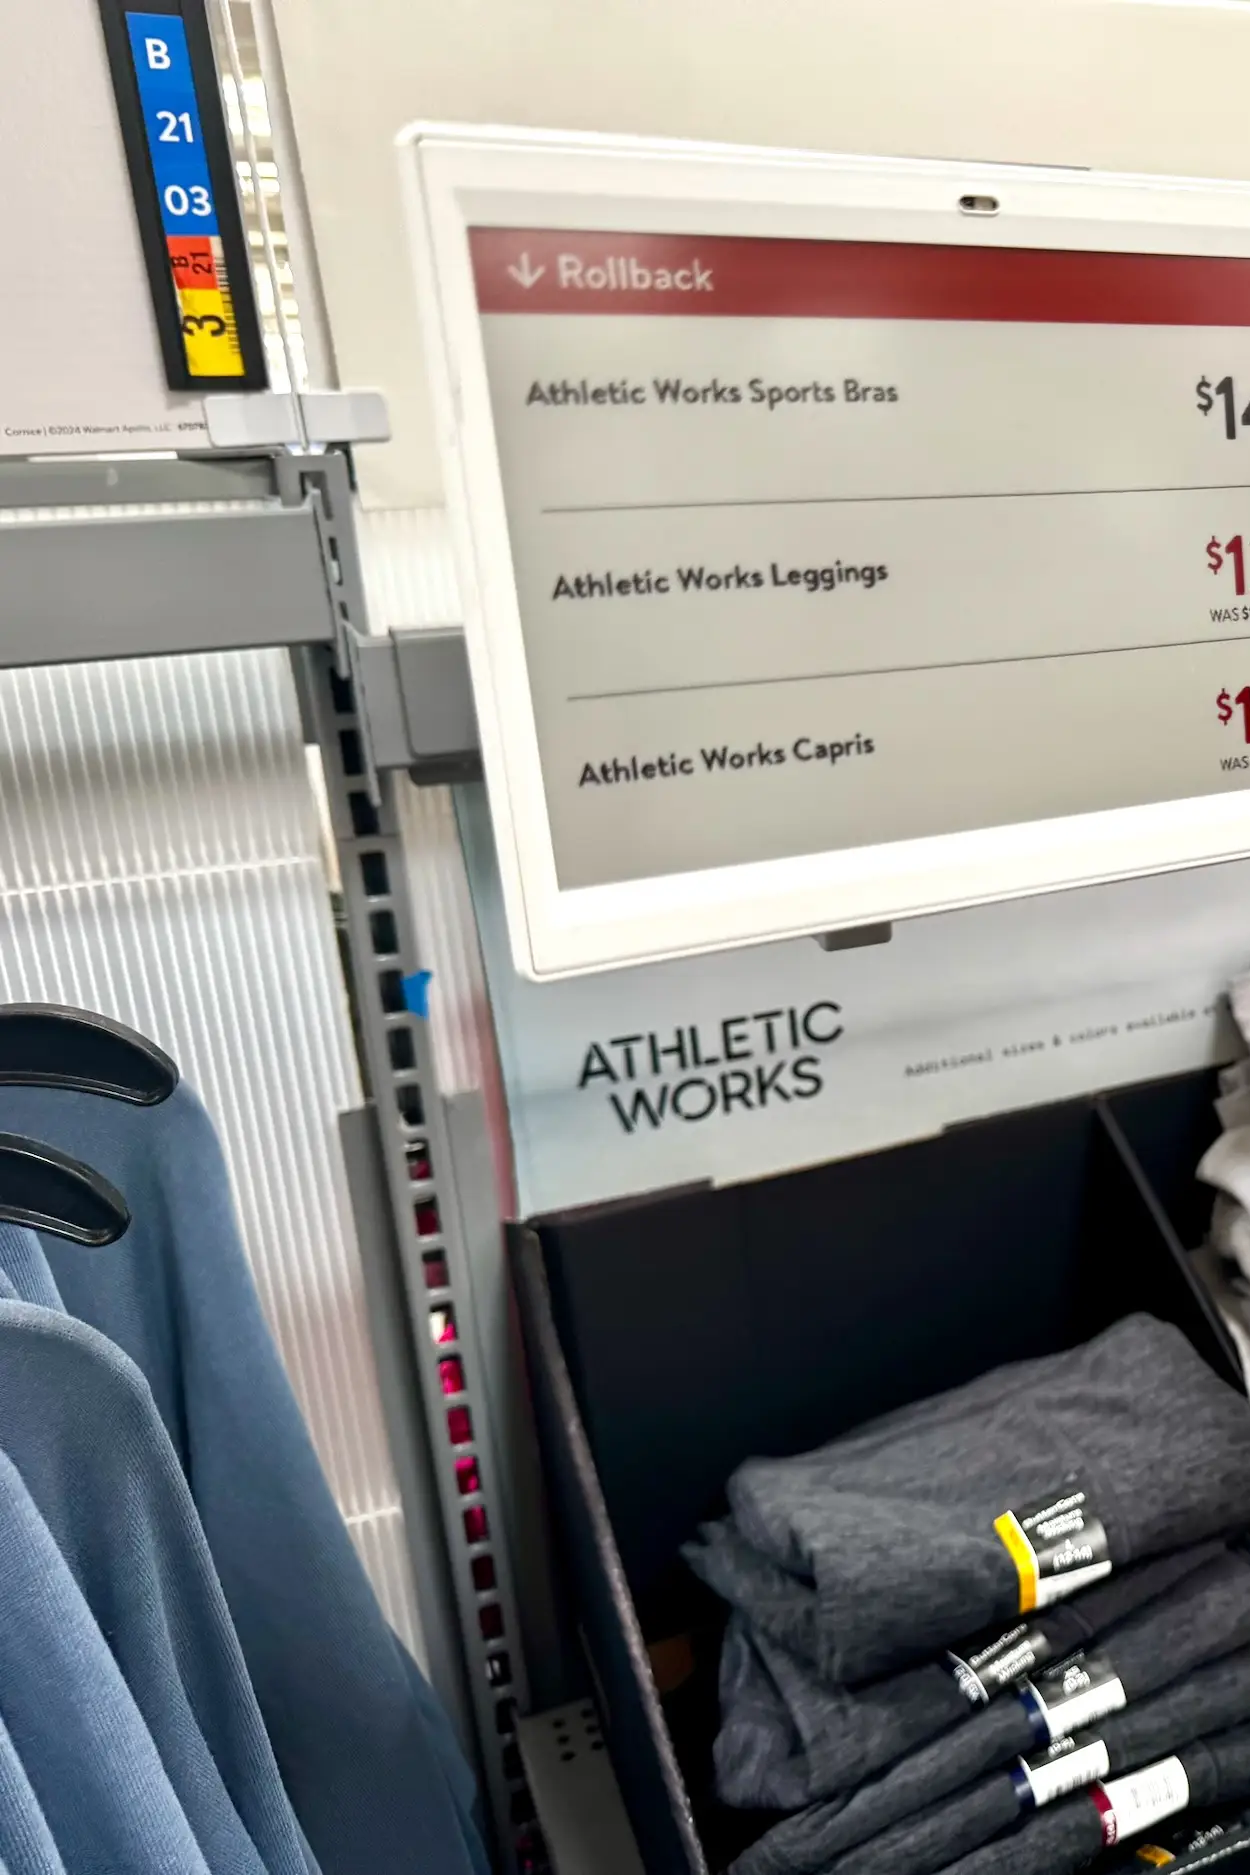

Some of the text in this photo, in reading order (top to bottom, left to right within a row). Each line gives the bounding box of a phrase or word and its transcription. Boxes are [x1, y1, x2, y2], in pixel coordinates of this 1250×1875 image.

[145, 38, 171, 69] B
[156, 111, 194, 142] 21
[164, 186, 212, 216] 03
[170, 256, 189, 268] B
[190, 252, 213, 275] 21
[558, 254, 714, 292] Rollback
[181, 314, 226, 338] 3
[526, 377, 899, 411] Athletic Works Sports Bras
[552, 560, 889, 600] Athletic Works Leggings
[1210, 607, 1240, 623] WAS
[578, 733, 875, 788] Athletic Works Capris
[1220, 756, 1249, 772] WAS
[577, 1000, 844, 1090] ATHLETIC
[610, 1055, 823, 1134] WORKS
